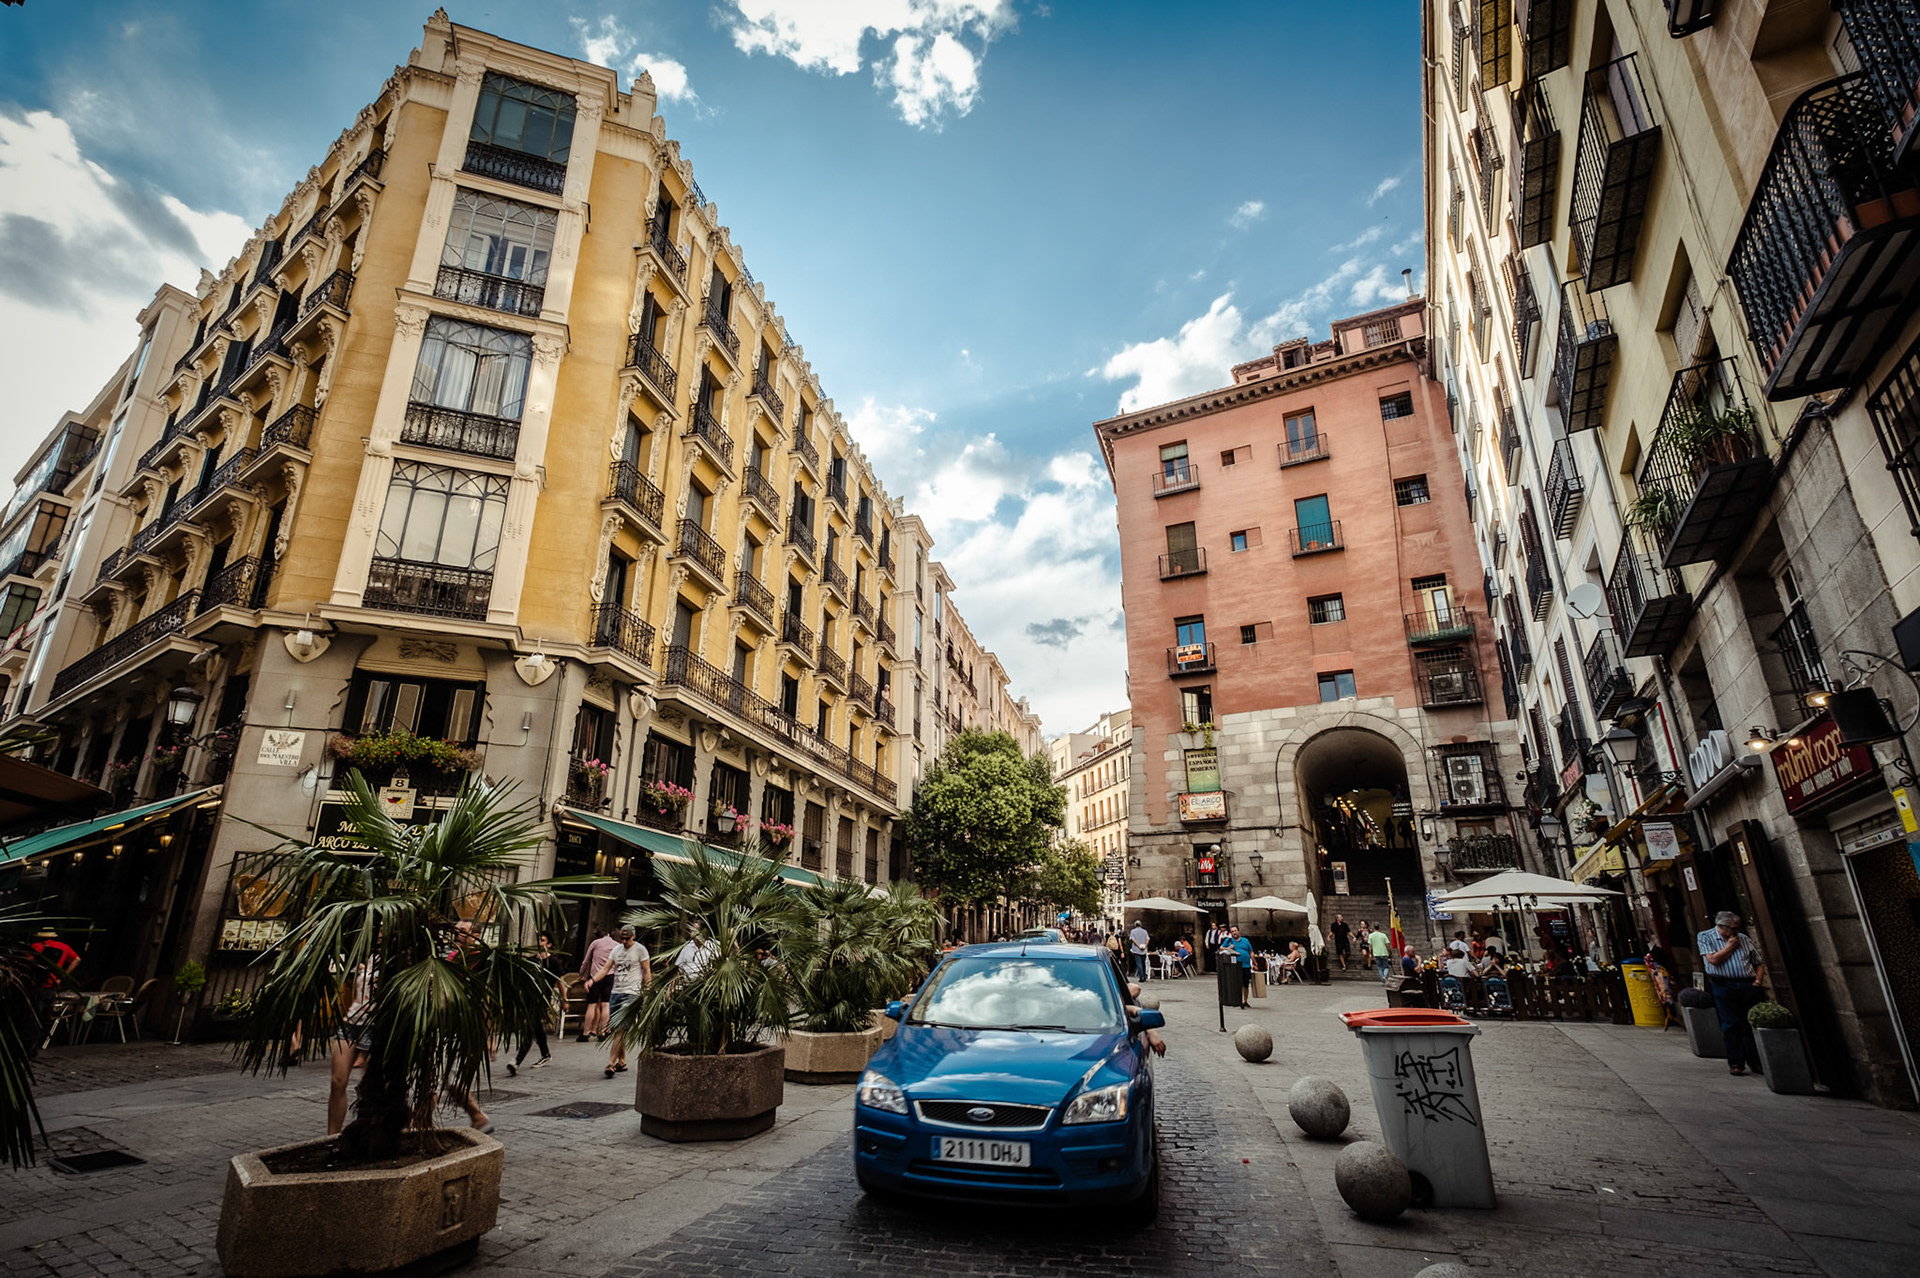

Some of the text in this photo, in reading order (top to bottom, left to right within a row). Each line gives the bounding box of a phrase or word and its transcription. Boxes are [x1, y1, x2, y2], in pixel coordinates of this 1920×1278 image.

[764, 709, 789, 736] HOSTAL
[791, 726, 800, 743] LA
[395, 779, 405, 788] 8
[1201, 796, 1221, 805] ARCO
[944, 1140, 1022, 1163] 2111 DHJ
